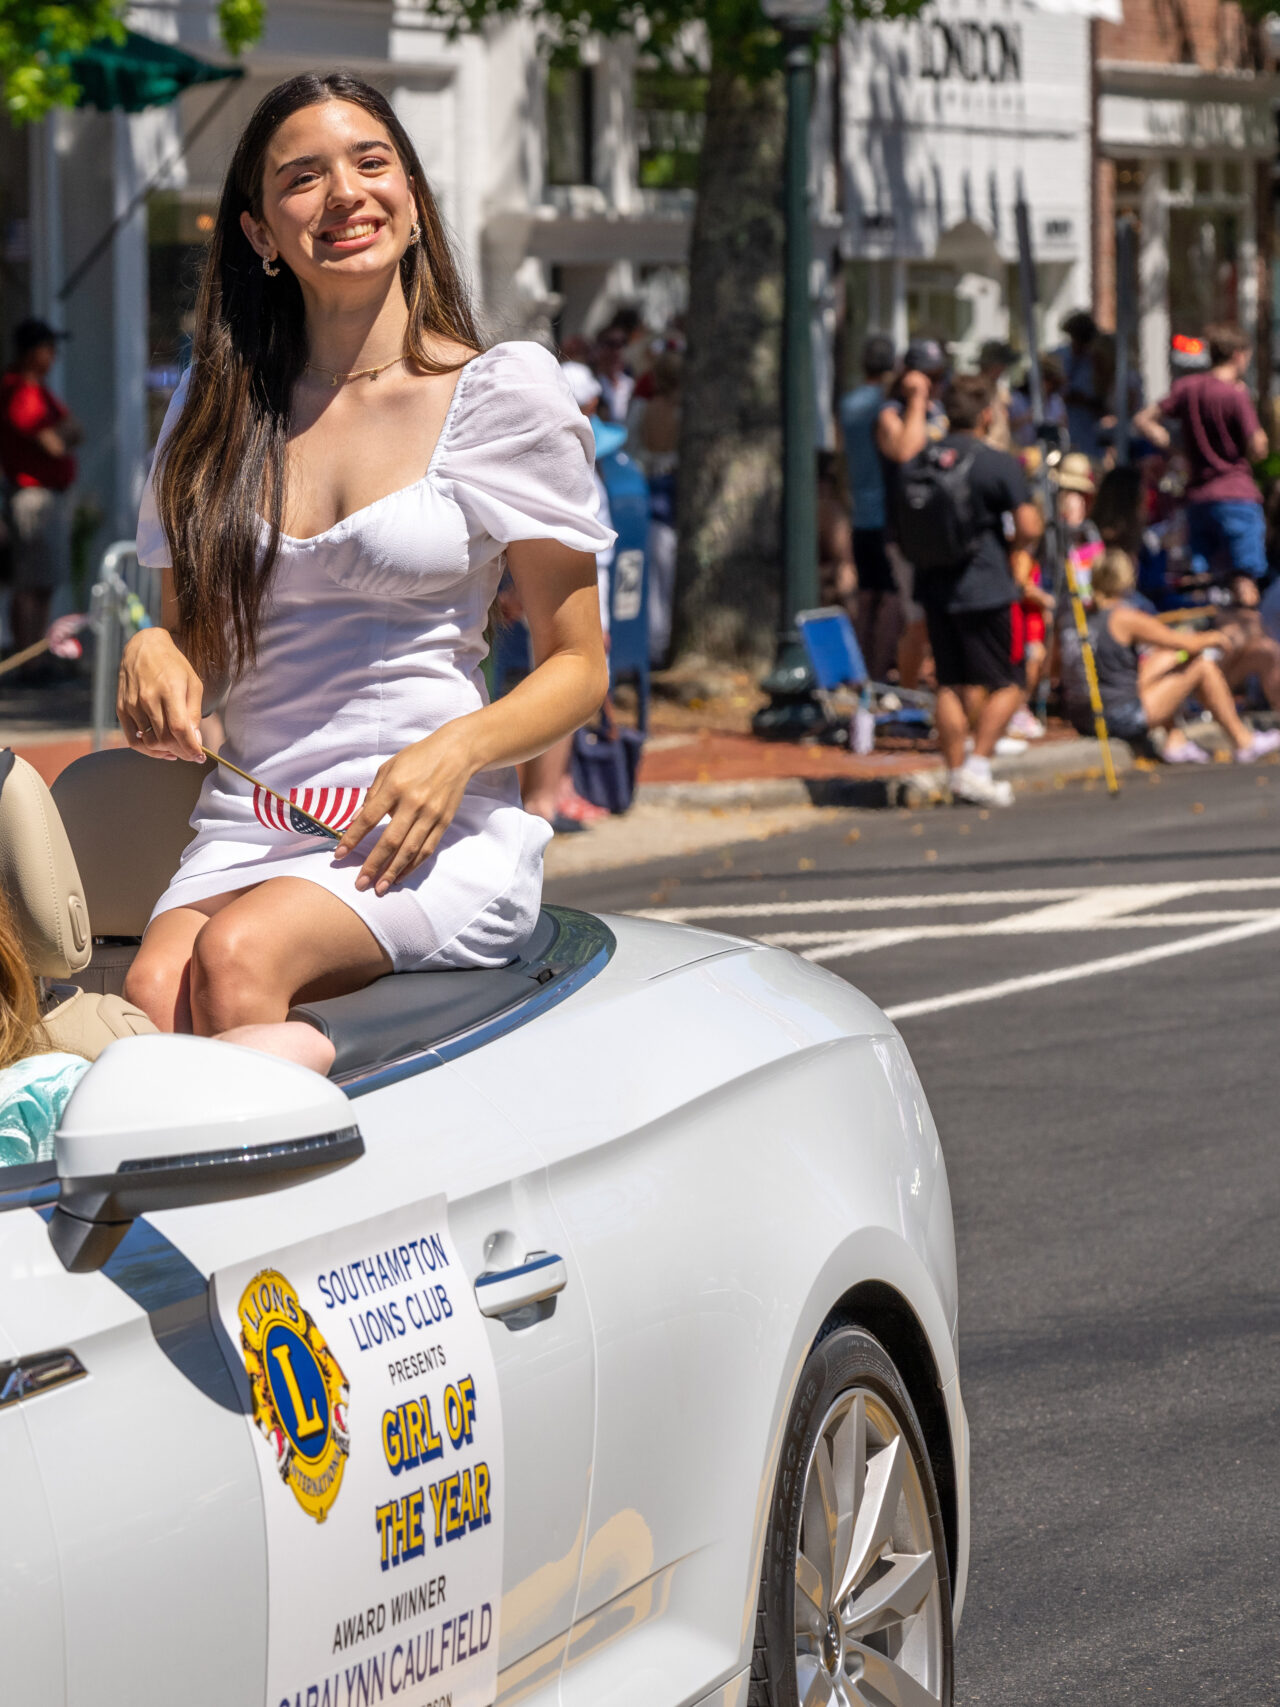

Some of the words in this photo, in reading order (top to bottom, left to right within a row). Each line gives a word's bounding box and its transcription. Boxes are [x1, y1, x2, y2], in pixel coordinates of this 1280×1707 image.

[921, 19, 1021, 82] LONDON
[244, 1283, 299, 1333] LIONS
[317, 1232, 450, 1309] SOUTHAMPTON
[349, 1302, 406, 1351] LIONS
[405, 1284, 453, 1329] CLUB
[271, 1344, 326, 1441] L
[388, 1344, 447, 1386] PRESENTS
[381, 1394, 444, 1476] GIRL
[443, 1374, 476, 1450] OF
[375, 1486, 425, 1572] THE
[428, 1461, 492, 1548] YEAR
[332, 1603, 386, 1655] AWARD
[390, 1575, 447, 1627] WINNER
[278, 1652, 386, 1707] ALYNN
[389, 1602, 493, 1695] CAULFIELD
